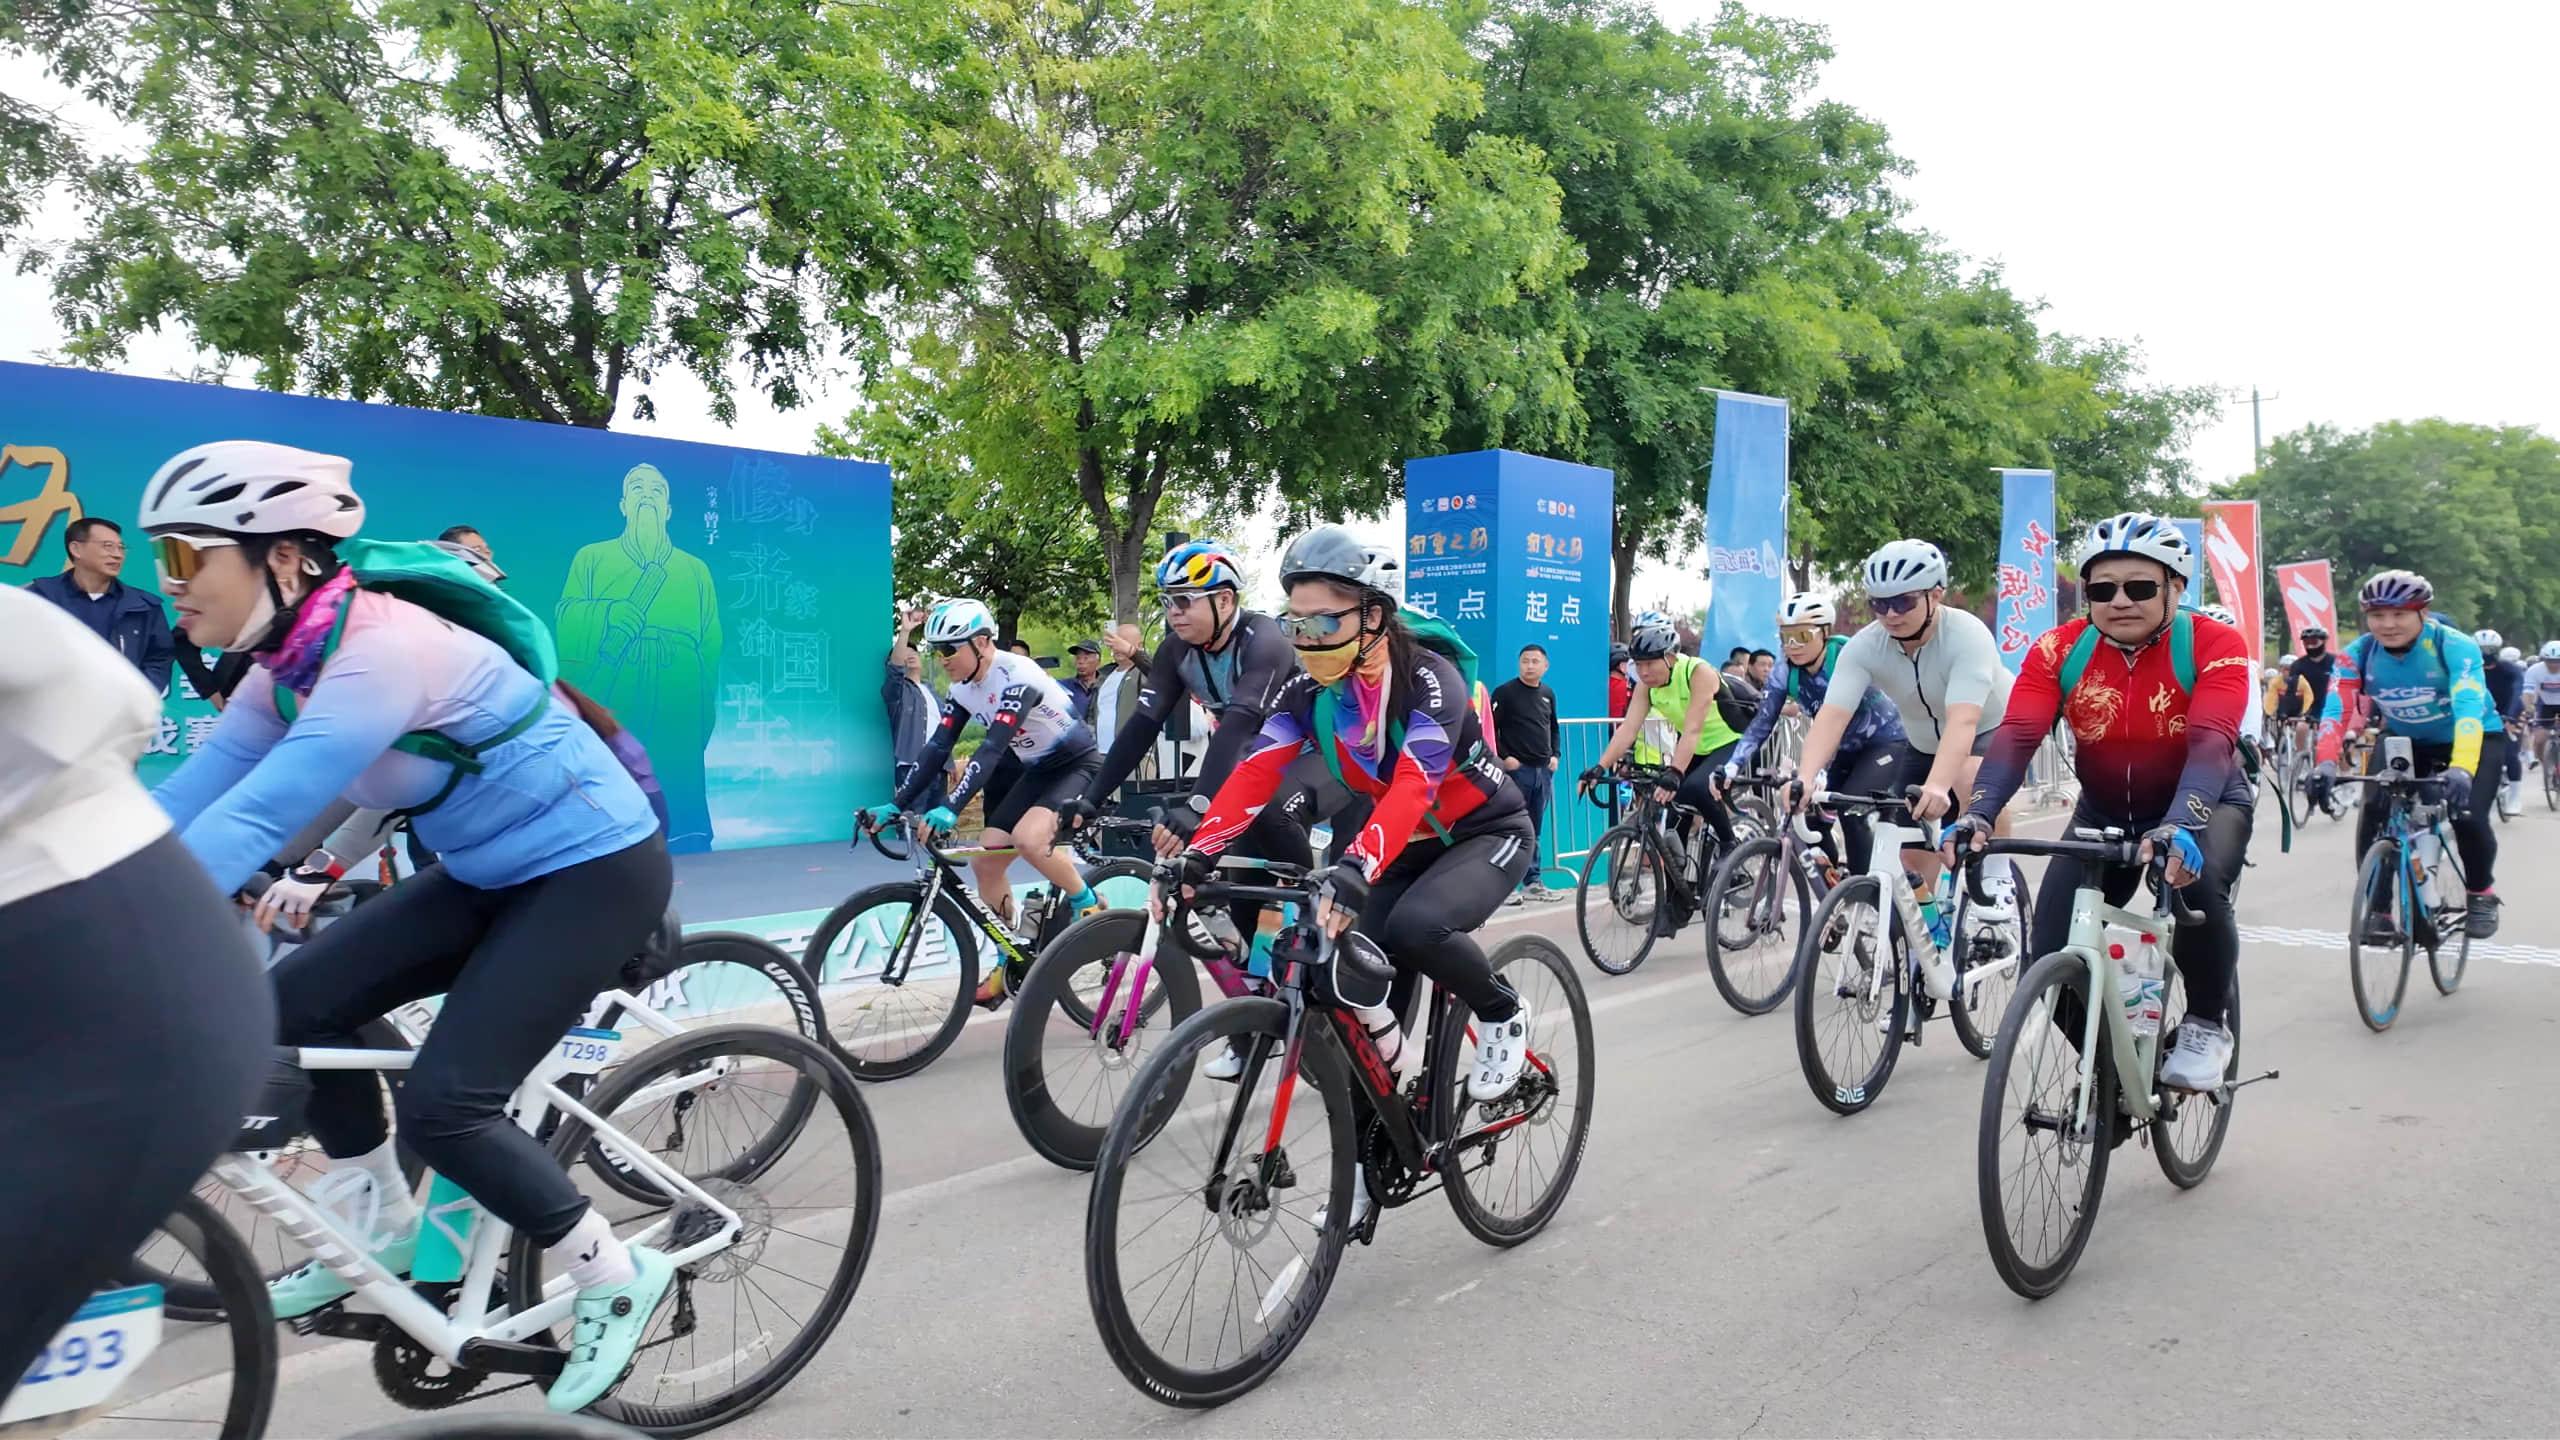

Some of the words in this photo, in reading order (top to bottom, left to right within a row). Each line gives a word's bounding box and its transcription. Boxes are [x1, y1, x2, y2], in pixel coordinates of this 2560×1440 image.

[704, 511, 720, 545] 曾子
[1525, 590, 1581, 625] 起点
[561, 1041, 608, 1062] T298
